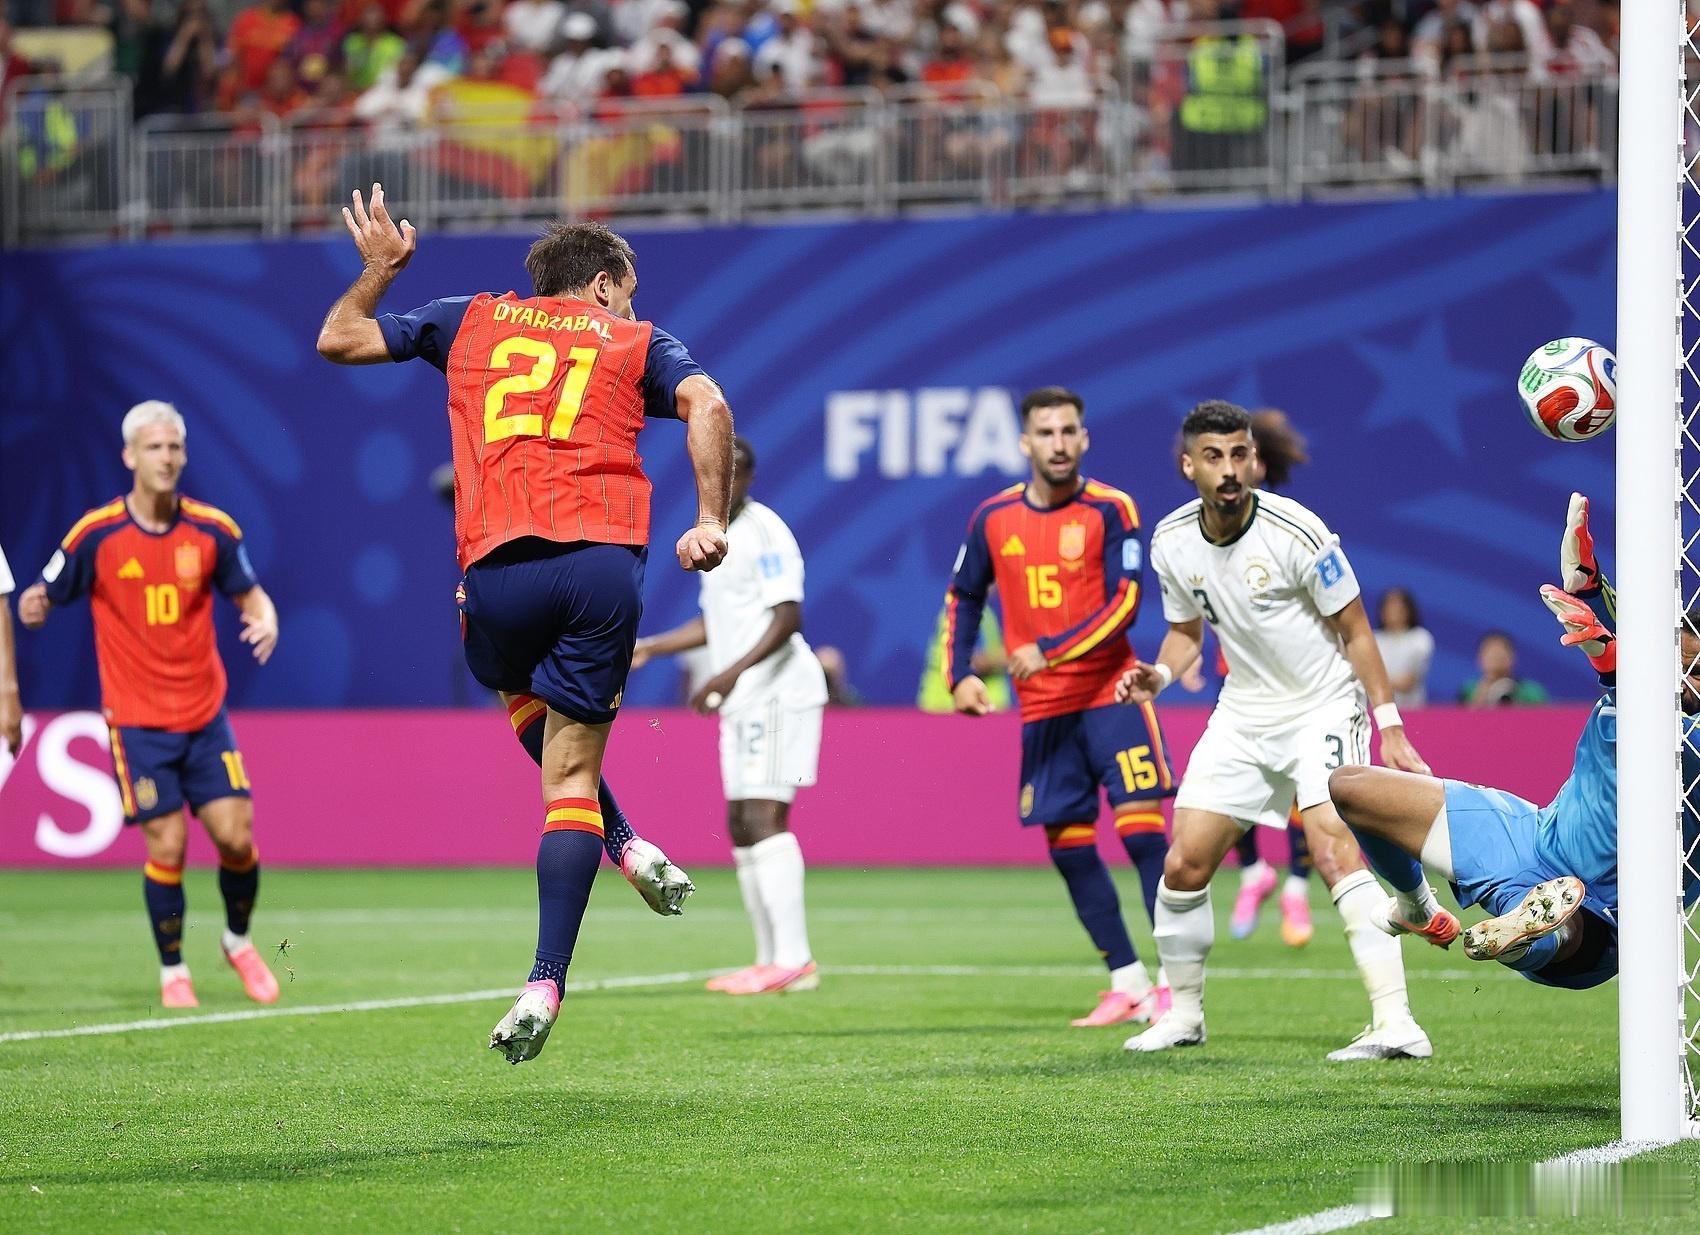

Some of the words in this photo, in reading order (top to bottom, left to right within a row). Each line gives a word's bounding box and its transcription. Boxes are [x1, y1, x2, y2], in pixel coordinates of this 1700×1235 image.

[493, 302, 613, 341] OYARZABAL
[484, 336, 599, 444] 21
[825, 385, 1028, 481] FIFA
[145, 584, 180, 625] 10
[1025, 564, 1063, 609] 15
[1193, 589, 1219, 624] 3
[1116, 745, 1158, 793] 15
[1325, 734, 1344, 770] 3
